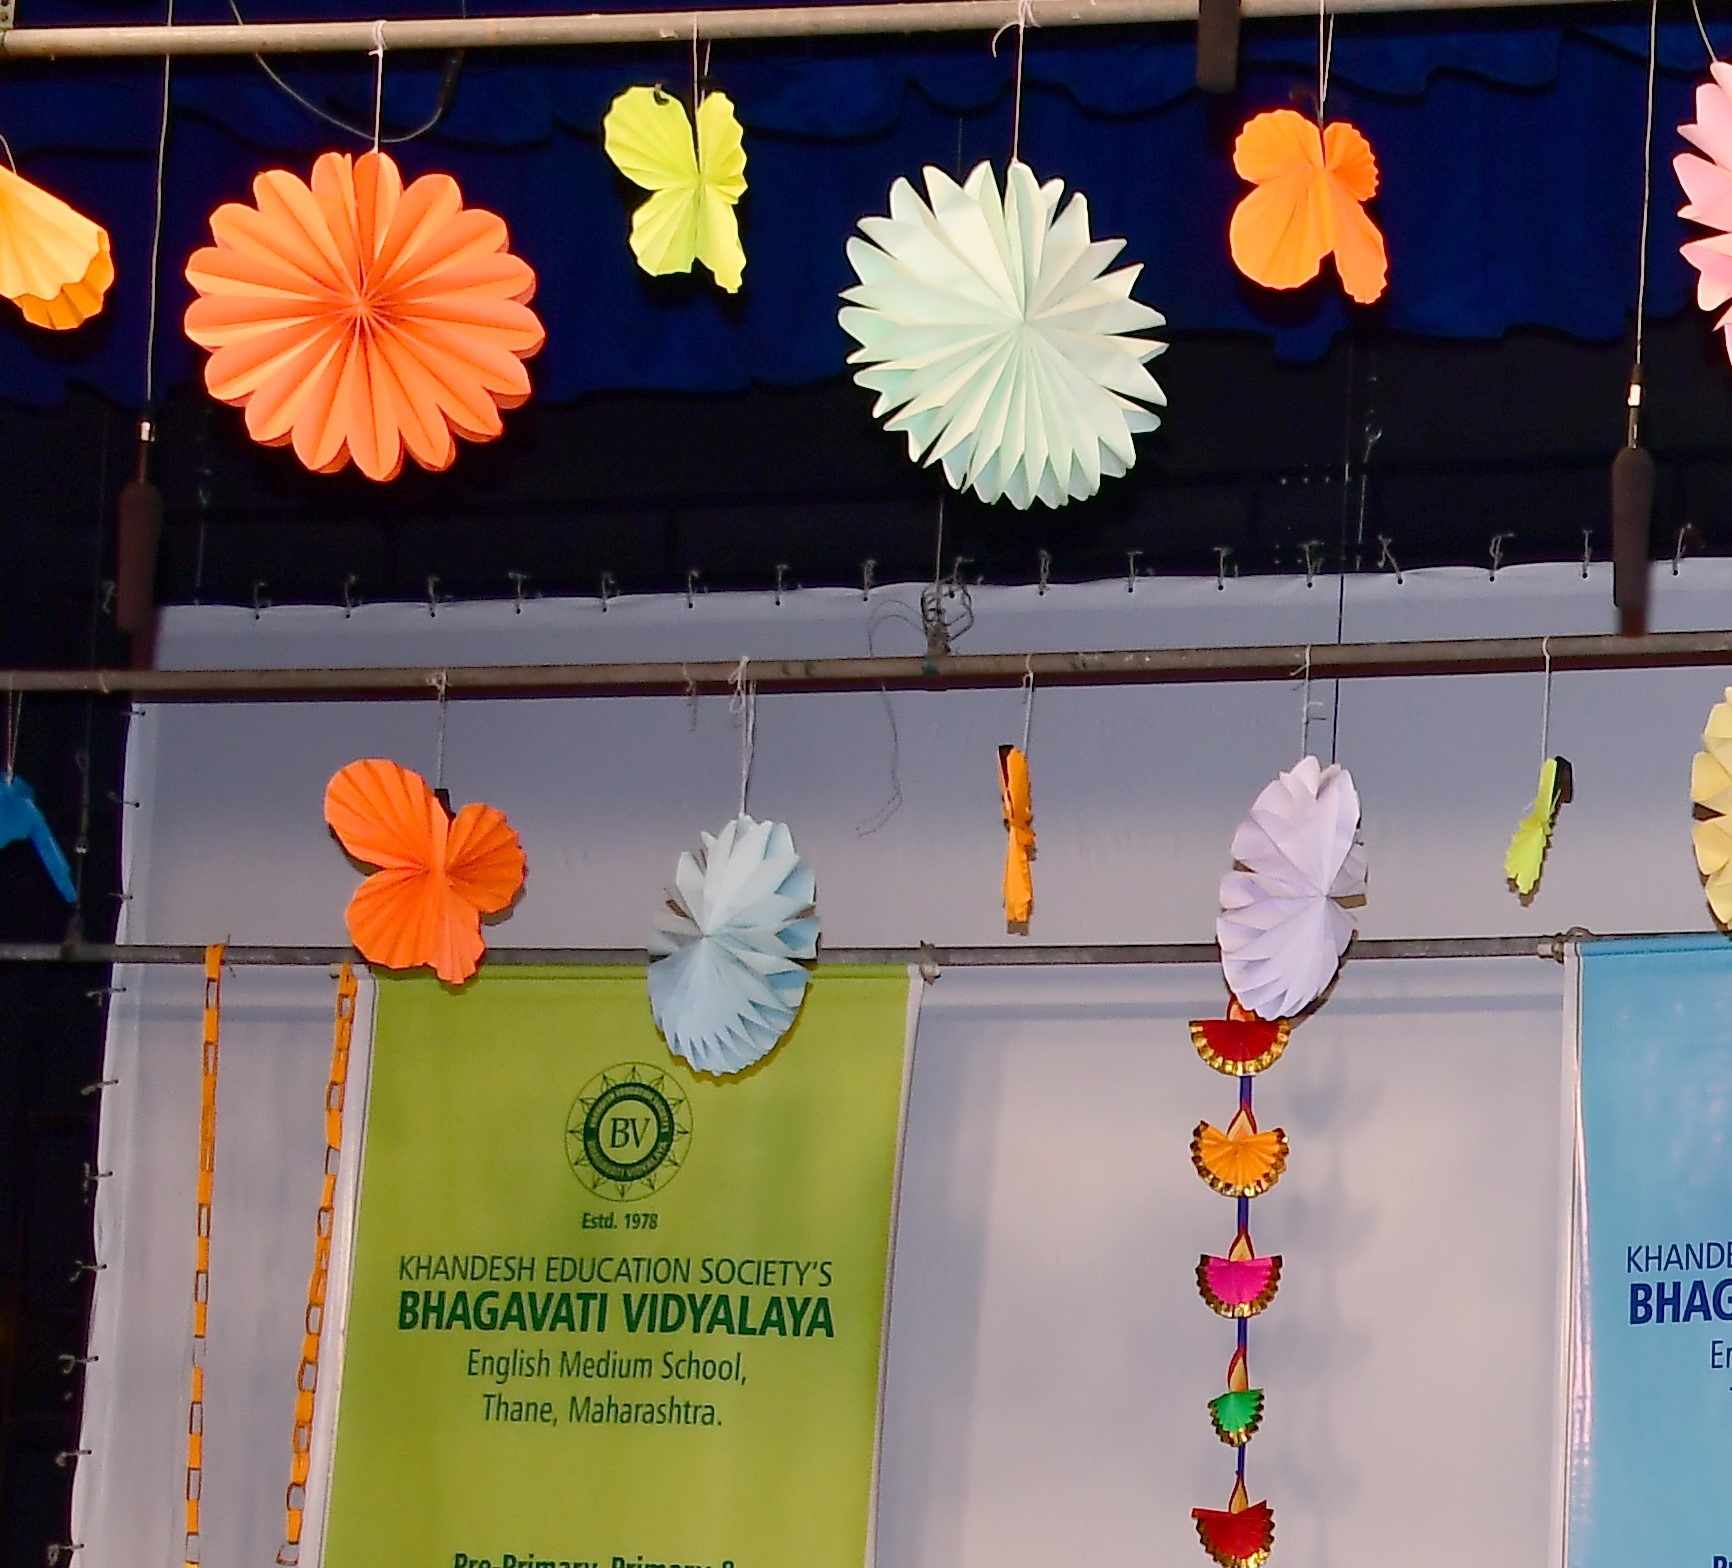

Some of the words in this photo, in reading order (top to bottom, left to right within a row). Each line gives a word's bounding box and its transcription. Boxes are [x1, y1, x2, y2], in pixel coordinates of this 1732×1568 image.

[610, 1117, 650, 1148] BV
[582, 1212, 617, 1229] Estd.
[625, 1213, 658, 1229] 1978
[399, 1255, 535, 1281] KHANDESH
[545, 1256, 690, 1284] EDUCATION
[700, 1258, 832, 1287] SOCIETY'S
[398, 1290, 608, 1332] BHAGAVATI
[622, 1293, 834, 1337] VIDYALAYA
[467, 1349, 550, 1384] English
[560, 1350, 653, 1378] Medium
[661, 1350, 746, 1386] School,
[483, 1393, 558, 1427] Thane,
[569, 1395, 722, 1426] Maharashtra.
